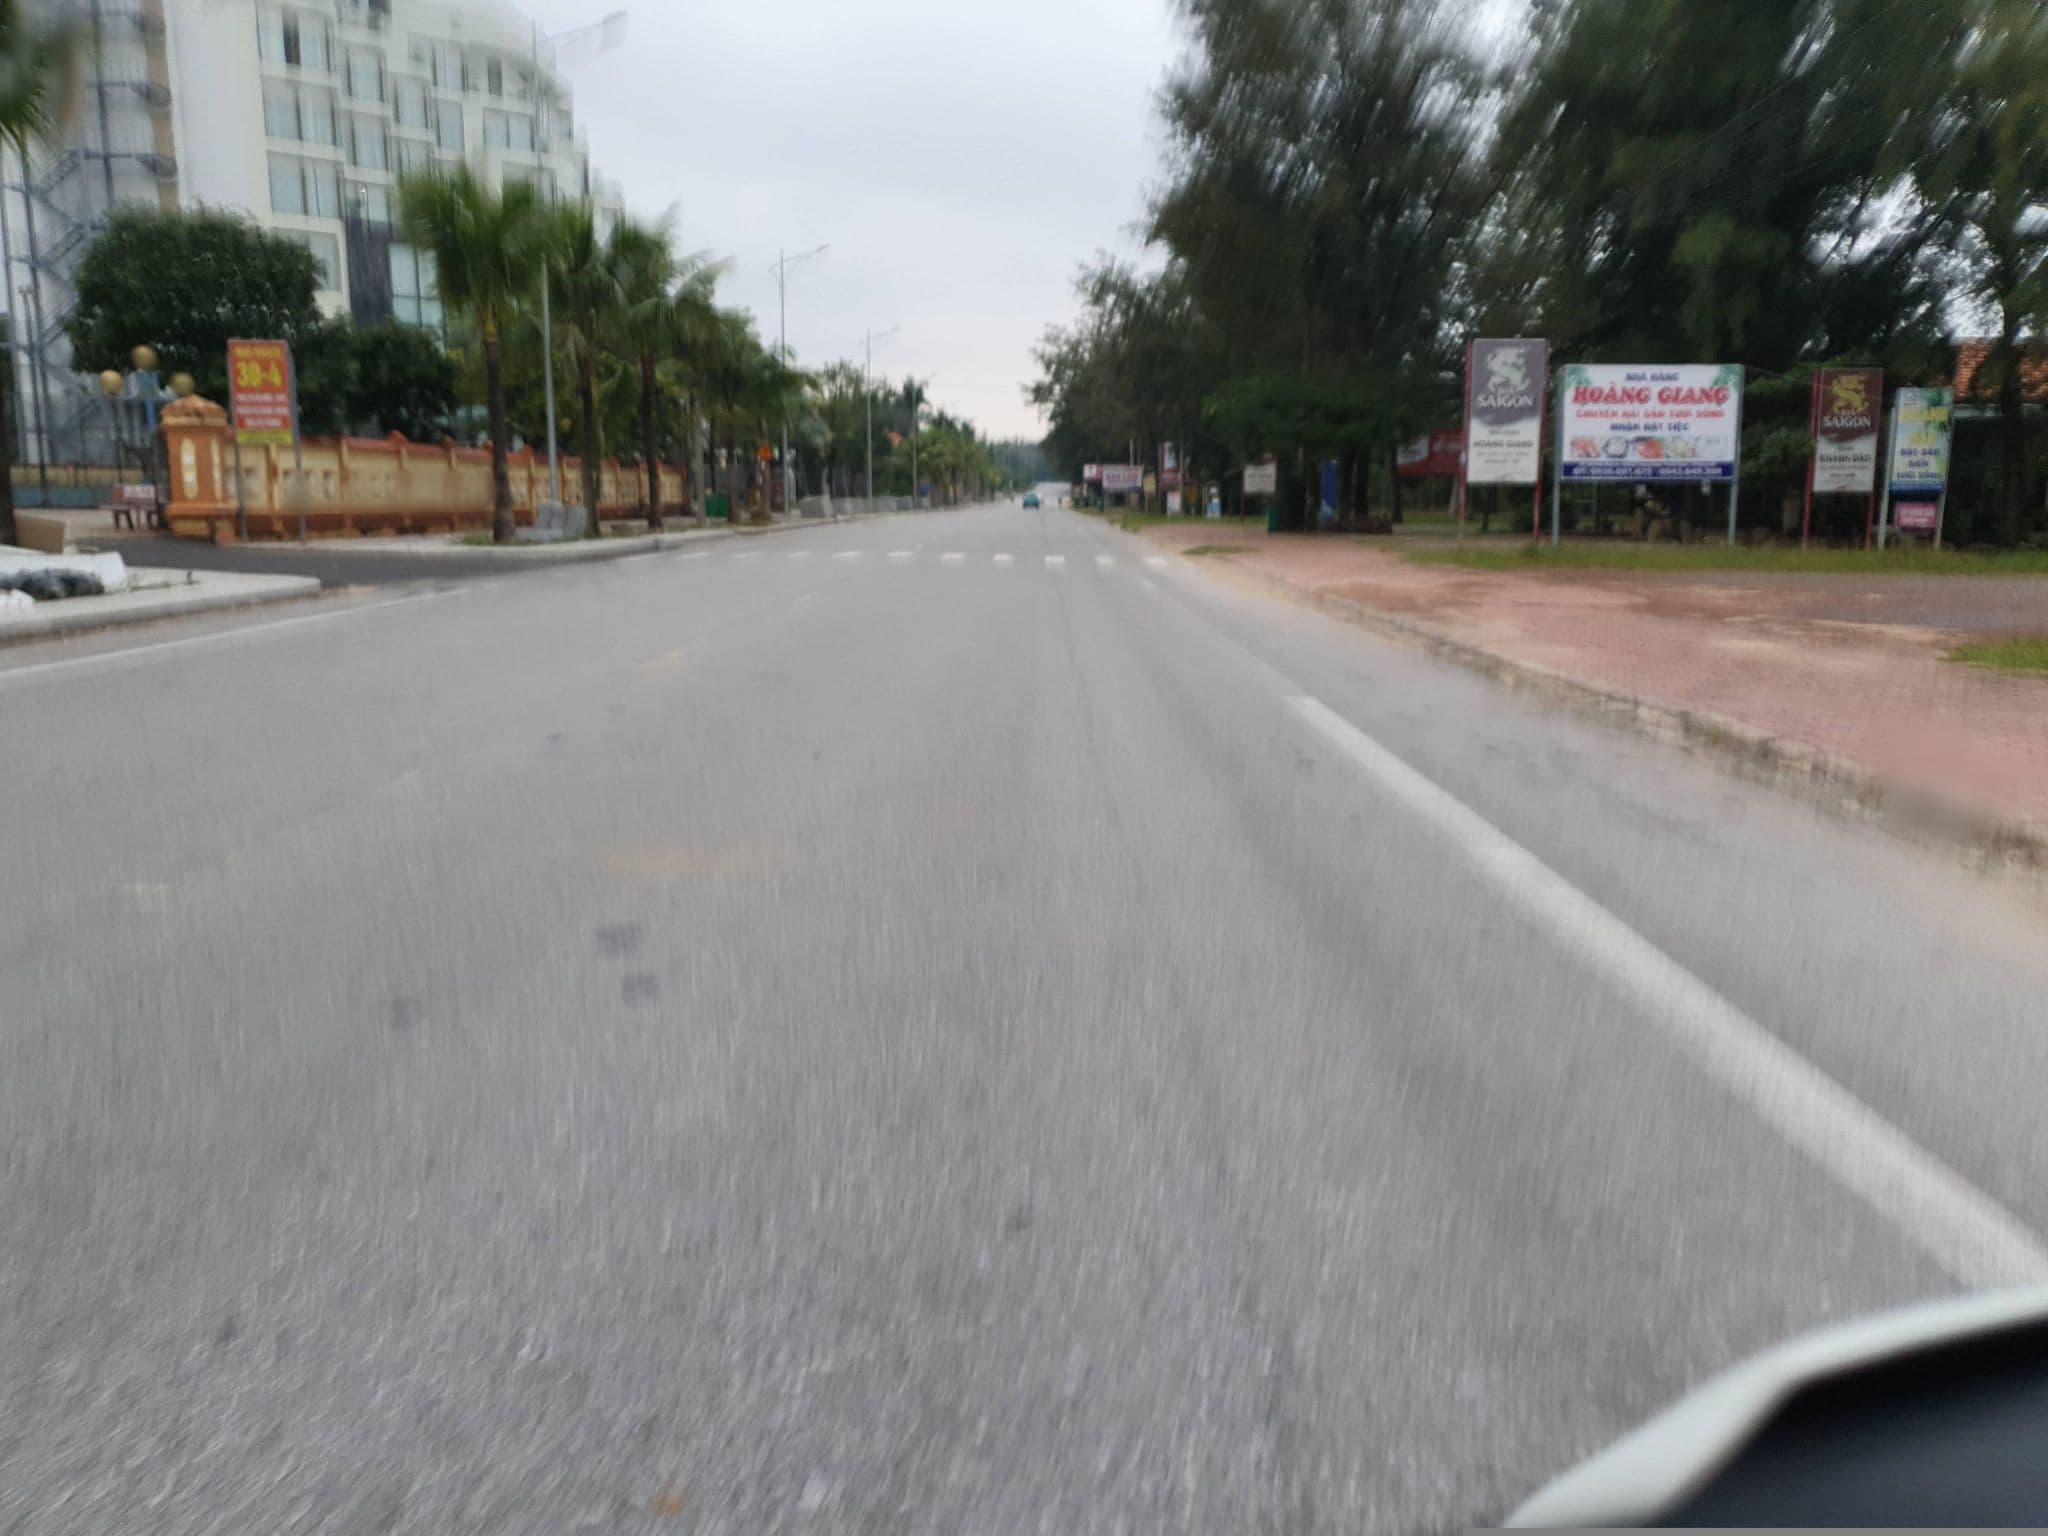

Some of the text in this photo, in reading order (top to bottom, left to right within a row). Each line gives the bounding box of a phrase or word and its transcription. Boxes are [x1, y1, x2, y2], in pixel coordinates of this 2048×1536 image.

[1478, 393, 1534, 408] SAIGON
[1656, 386, 1730, 405] GIANG
[1823, 415, 1872, 428] SAIGON
